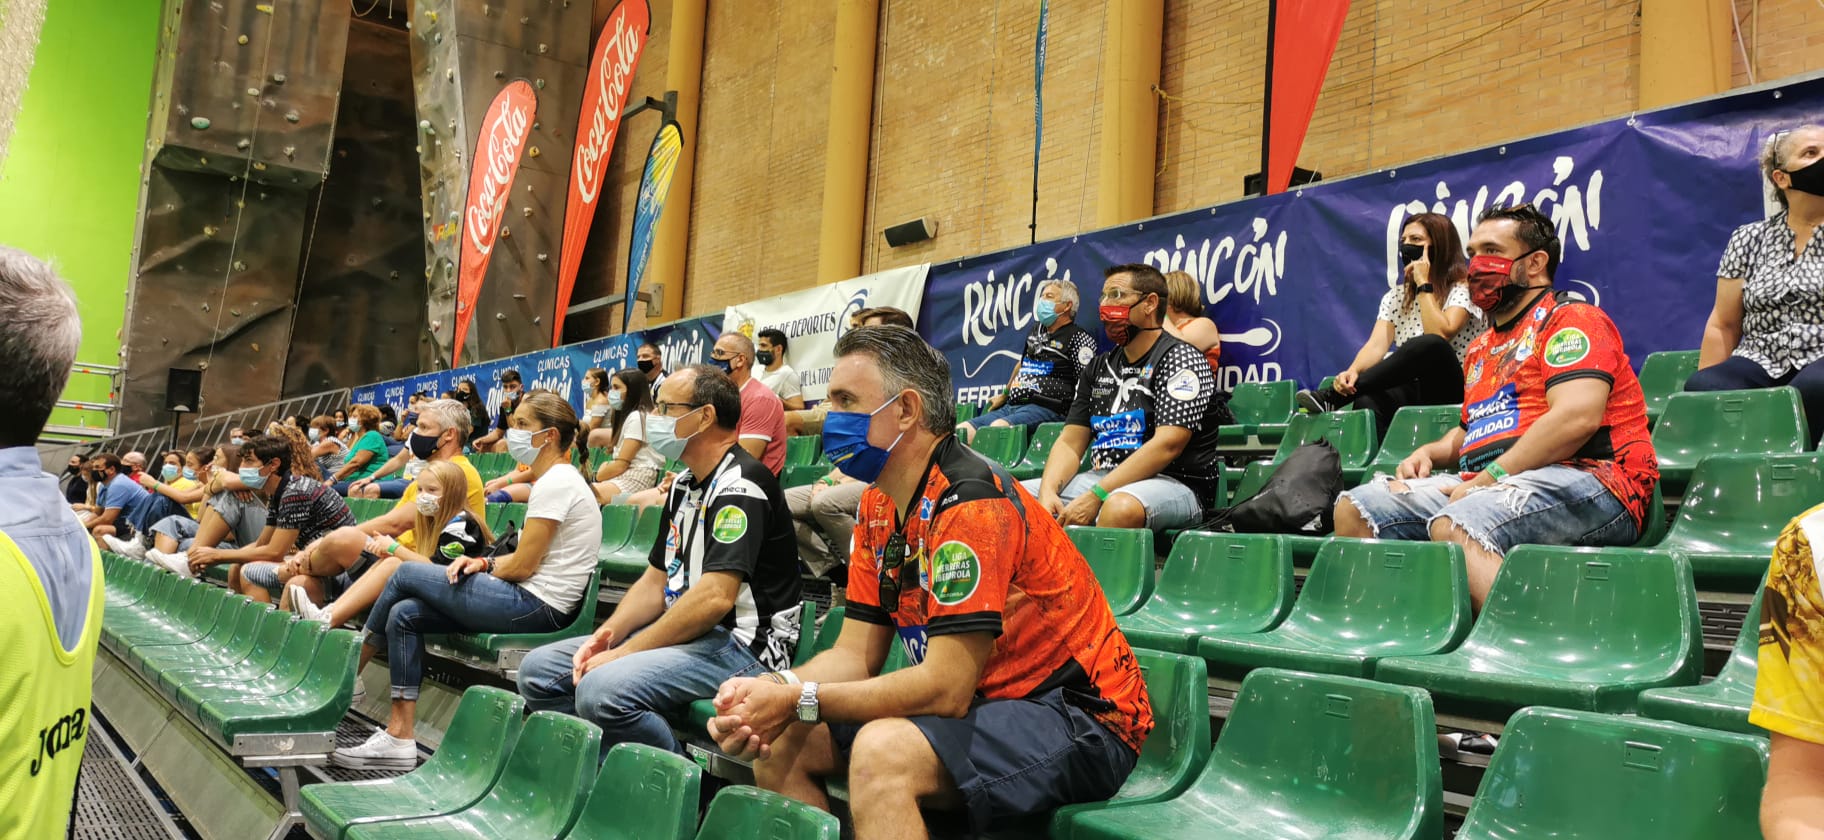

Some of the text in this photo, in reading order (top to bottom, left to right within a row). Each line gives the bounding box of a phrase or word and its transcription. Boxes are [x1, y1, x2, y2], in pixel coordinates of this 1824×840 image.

[790, 312, 836, 338] DEPORTES
[593, 343, 629, 363] CLINICAS
[537, 355, 570, 373] CLINICAS
[808, 369, 817, 386] LA
[818, 367, 835, 385] TOR
[952, 552, 967, 561] LIGA
